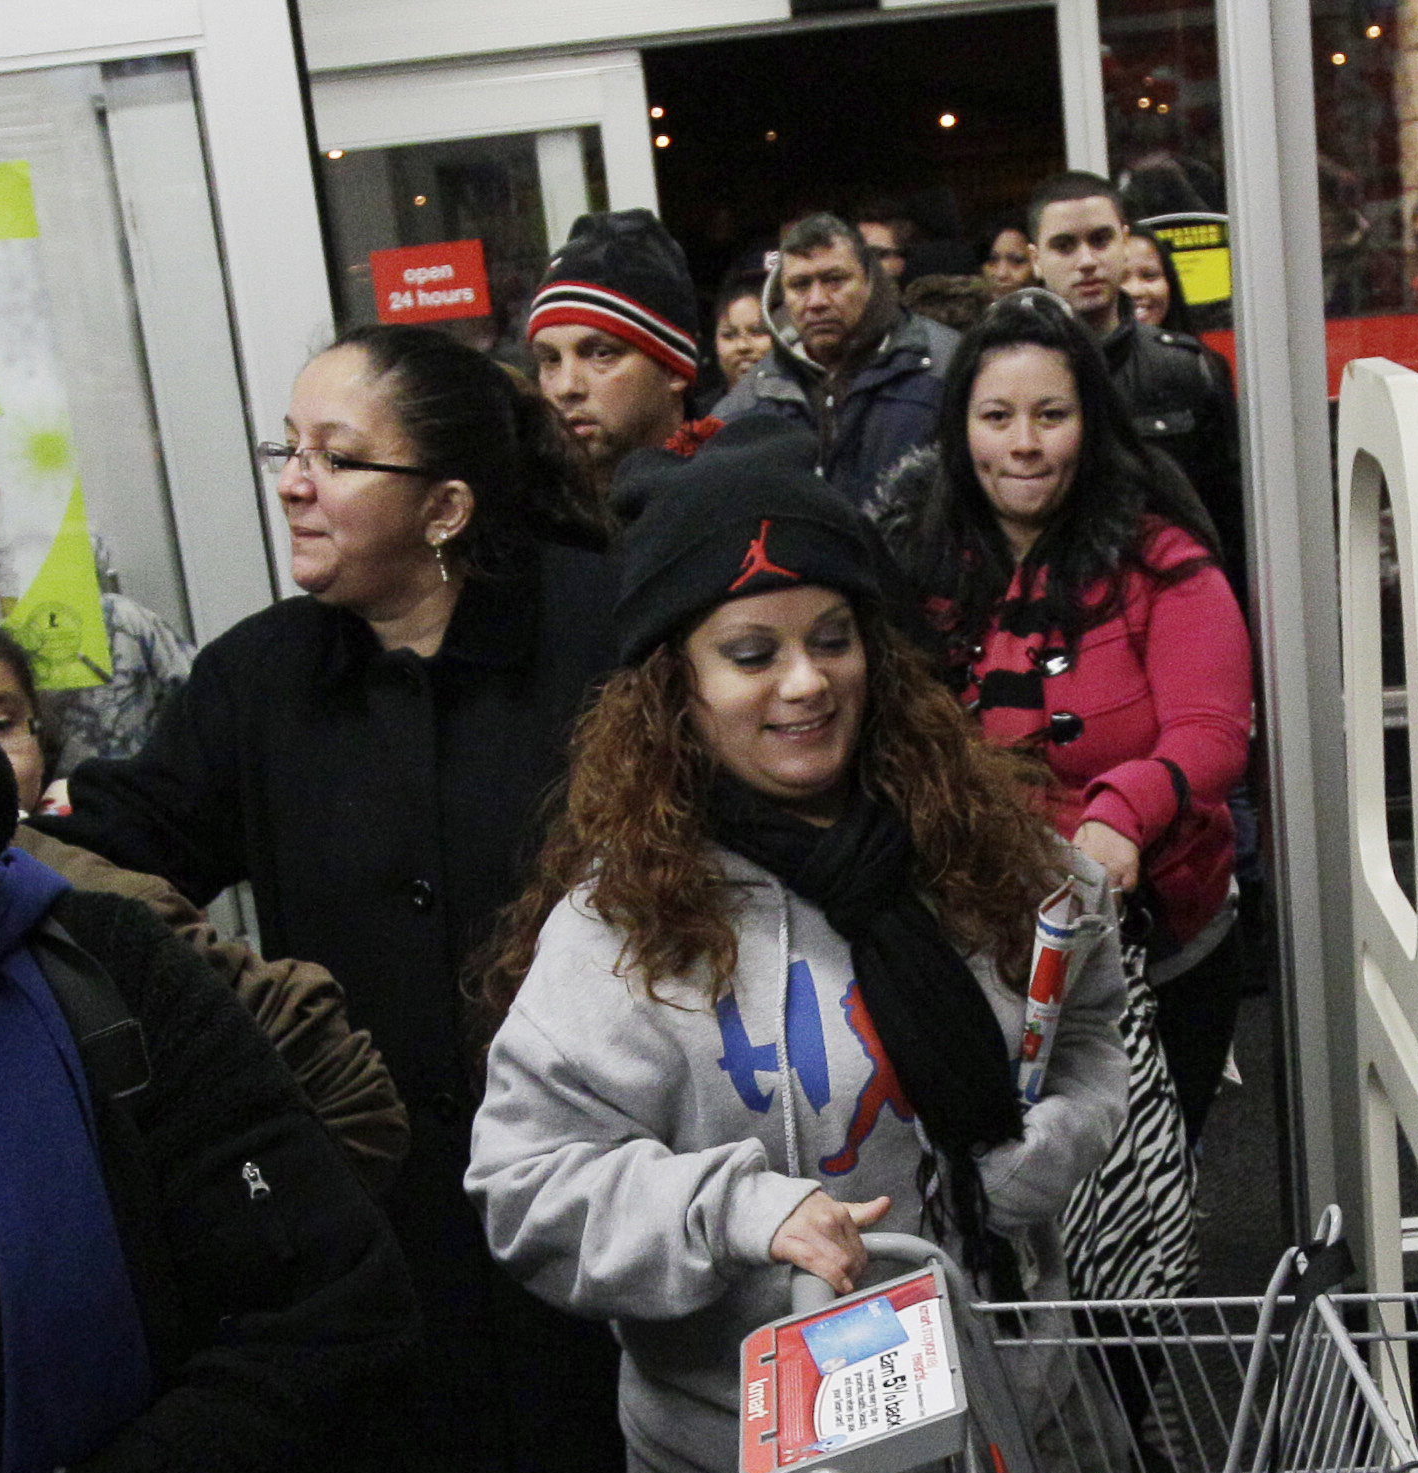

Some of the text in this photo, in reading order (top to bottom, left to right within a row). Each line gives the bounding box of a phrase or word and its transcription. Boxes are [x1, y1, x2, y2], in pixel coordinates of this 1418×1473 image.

[403, 264, 453, 285] open
[389, 287, 475, 311] 24 hours
[748, 1377, 771, 1421] kmart
[879, 1351, 907, 1427] Earn 5% back
